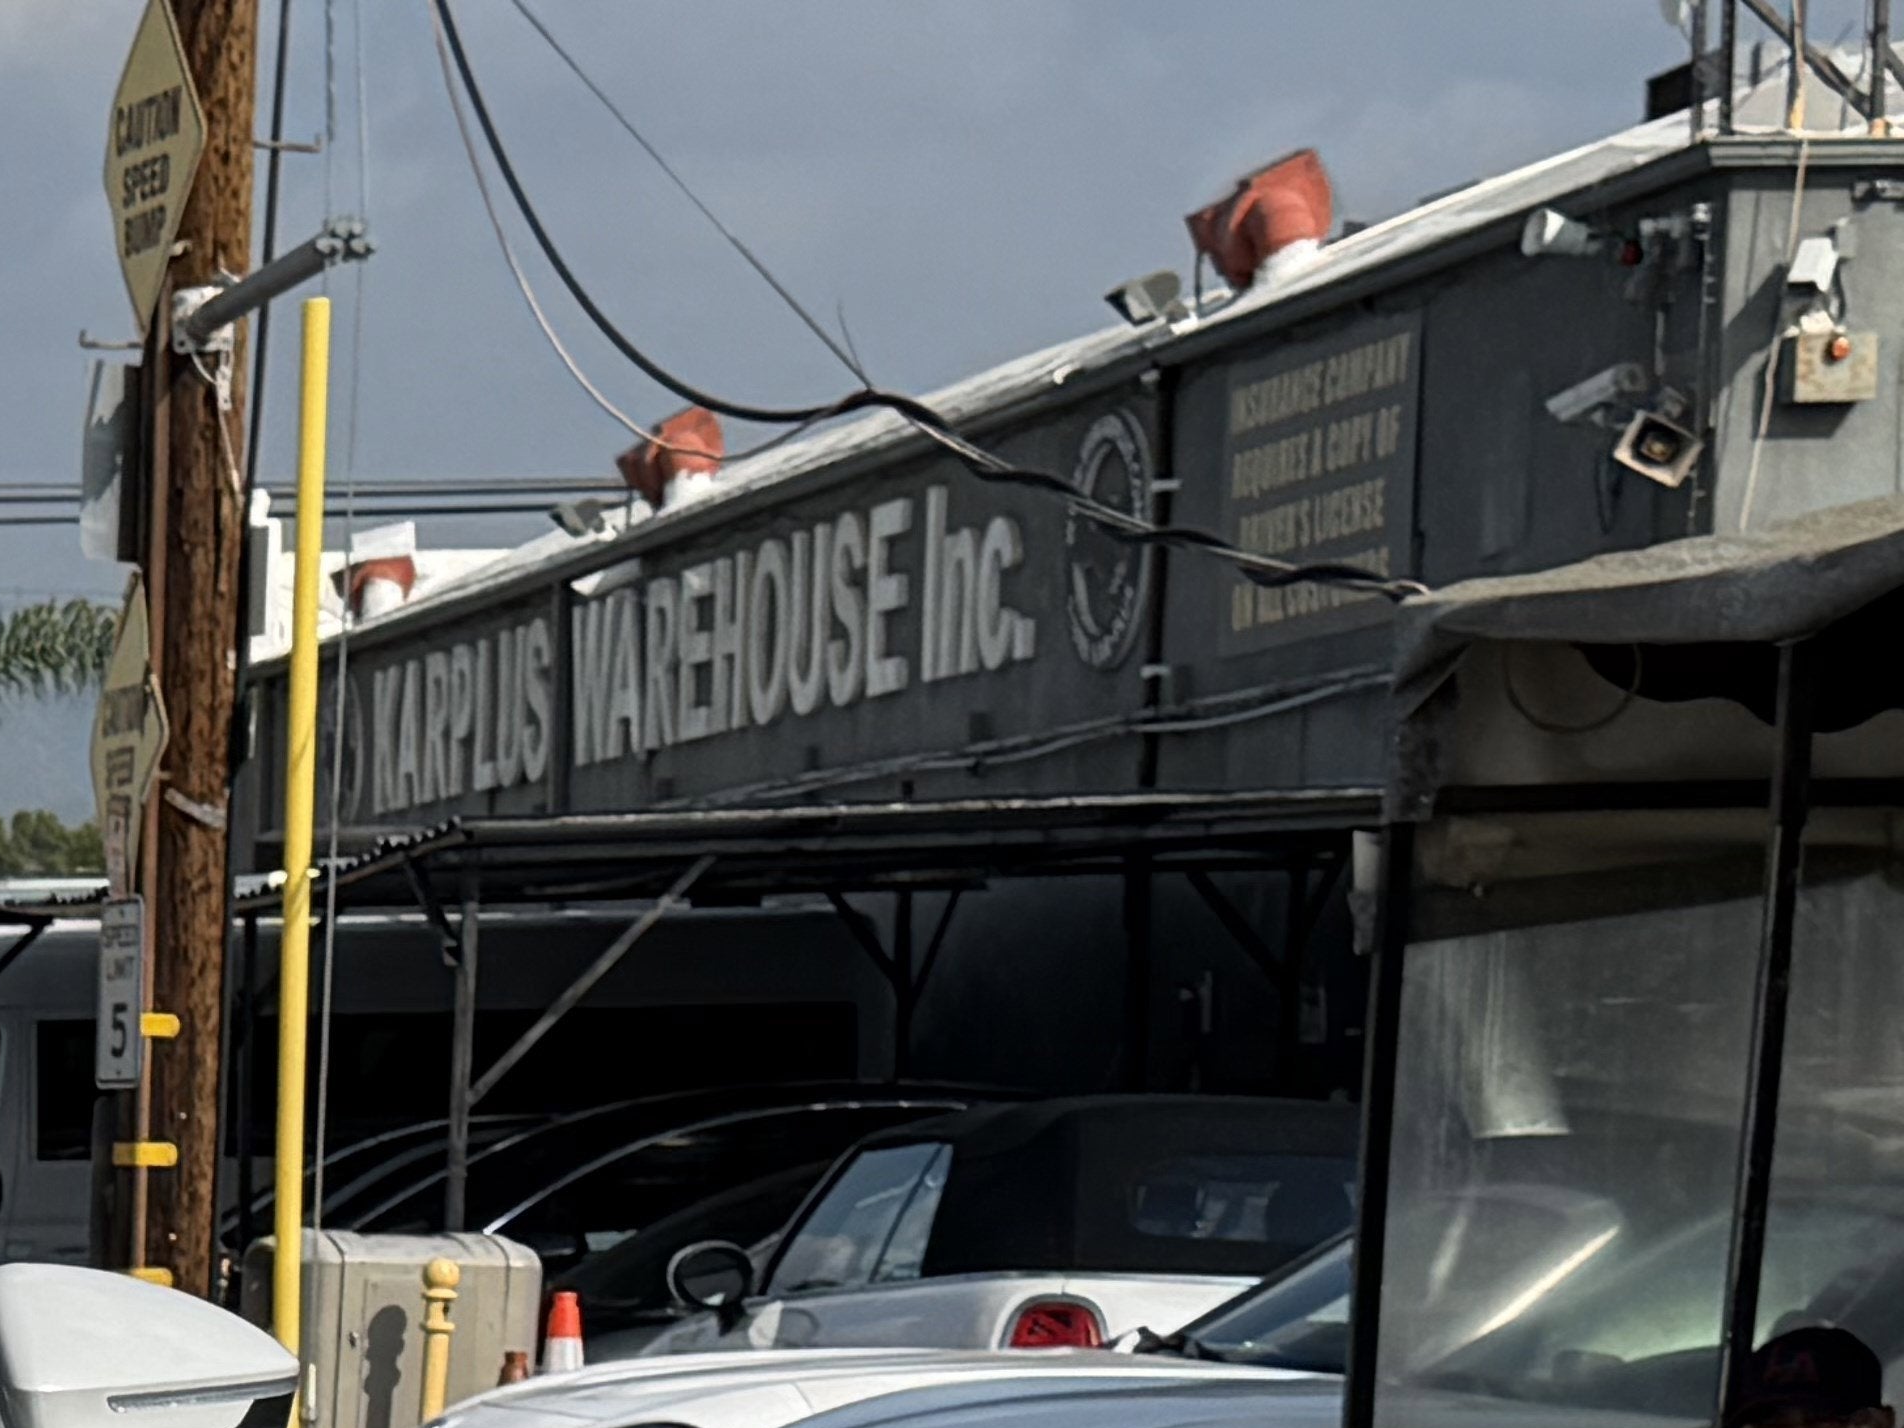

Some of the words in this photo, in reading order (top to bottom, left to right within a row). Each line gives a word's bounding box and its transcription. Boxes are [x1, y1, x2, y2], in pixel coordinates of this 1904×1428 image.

[116, 85, 182, 157] CAUTION
[123, 153, 170, 209] SPEED
[1326, 411, 1372, 472] COPY
[1376, 404, 1401, 458] OF
[1313, 477, 1385, 544] LICENSE
[373, 616, 553, 815] KARPLUS
[572, 498, 912, 766] WAREHOUSE
[922, 485, 1035, 683] Inc.
[111, 1003, 128, 1059] 5
